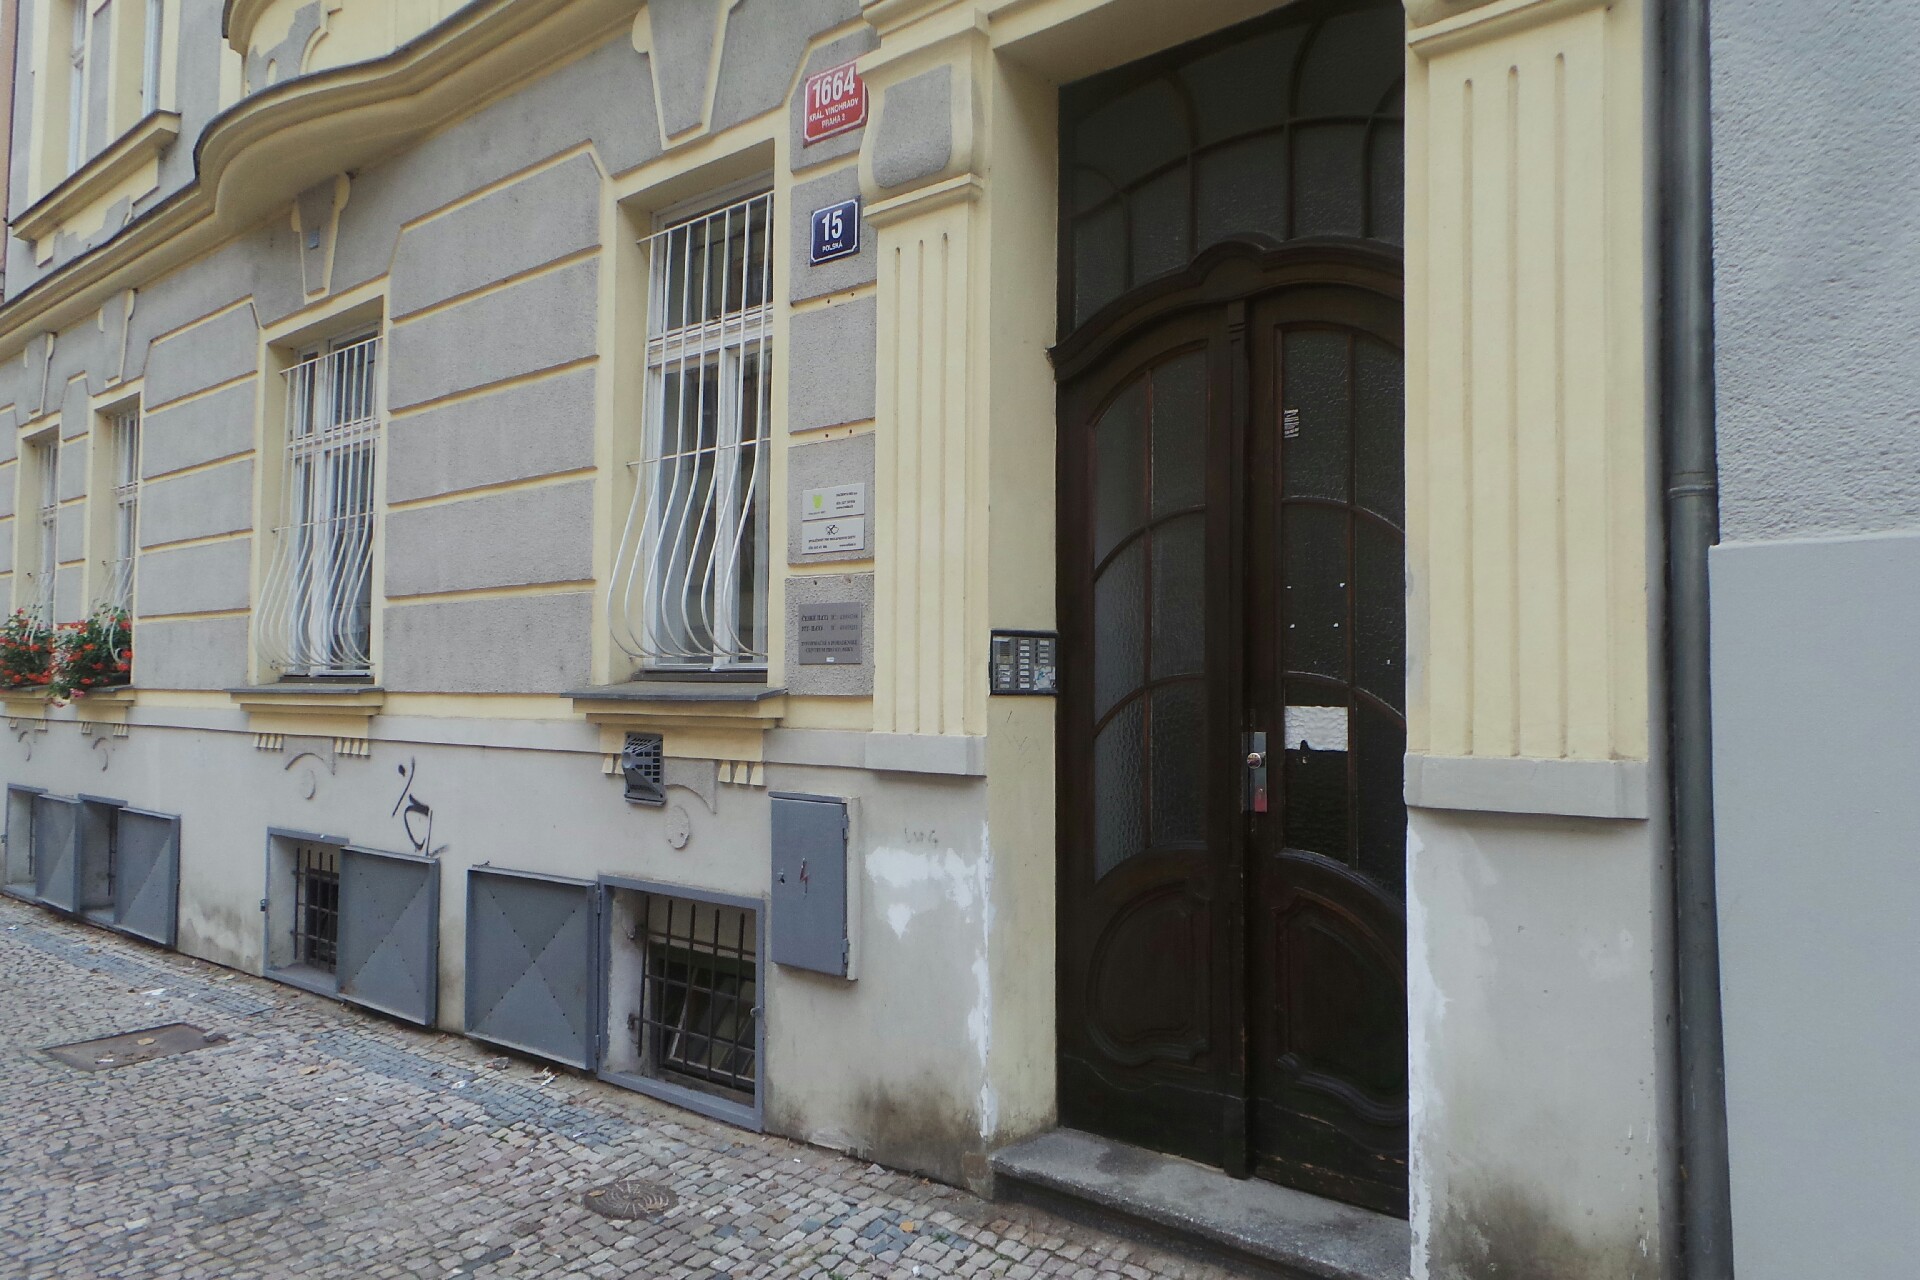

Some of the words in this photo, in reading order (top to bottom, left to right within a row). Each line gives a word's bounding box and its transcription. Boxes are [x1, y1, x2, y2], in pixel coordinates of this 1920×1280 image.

[813, 66, 855, 108] 1664
[825, 98, 859, 116] VINOHRADY
[821, 115, 841, 129] PRAHA
[821, 210, 843, 241] 15
[822, 240, 843, 252] POLSKÁ
